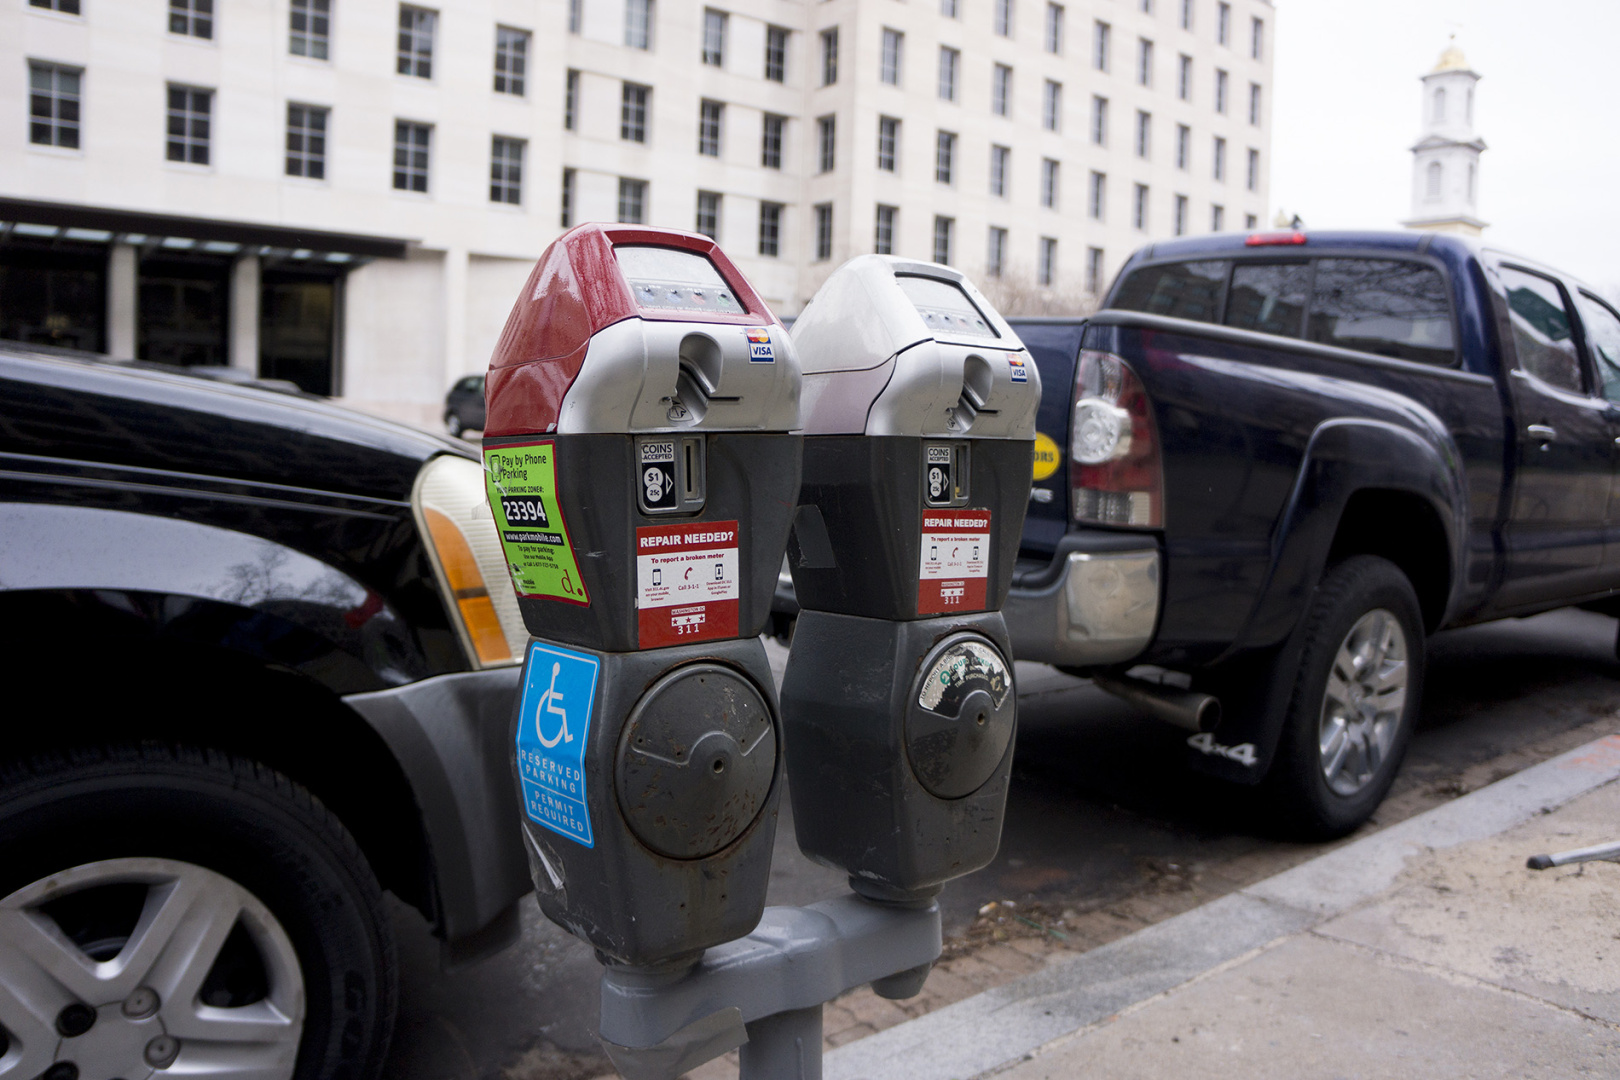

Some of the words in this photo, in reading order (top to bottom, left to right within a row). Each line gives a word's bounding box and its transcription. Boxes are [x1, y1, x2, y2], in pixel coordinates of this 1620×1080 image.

[752, 346, 772, 356] VISA
[1012, 368, 1026, 377] VISA
[643, 444, 672, 454] COINS
[928, 448, 949, 456] COINS
[502, 456, 514, 468] Pay
[514, 455, 523, 467] by
[524, 454, 546, 465] Phone
[502, 468, 528, 480] Parking
[648, 472, 658, 482] $1
[932, 472, 940, 480] $1
[502, 501, 546, 521] 23394
[924, 518, 952, 527] REPAIR
[954, 518, 988, 528] NEEDED?
[505, 532, 562, 544] www.parkmobile.com
[640, 534, 682, 548] REPAIR
[684, 531, 734, 544] NEEDED?
[660, 556, 679, 564] report
[924, 668, 940, 690] REPORT
[1187, 732, 1257, 766] 4x4
[522, 750, 580, 781] RESERVED
[526, 764, 576, 793] PARKING
[534, 790, 573, 816] PERMIT
[531, 800, 584, 832] REQUIRED
